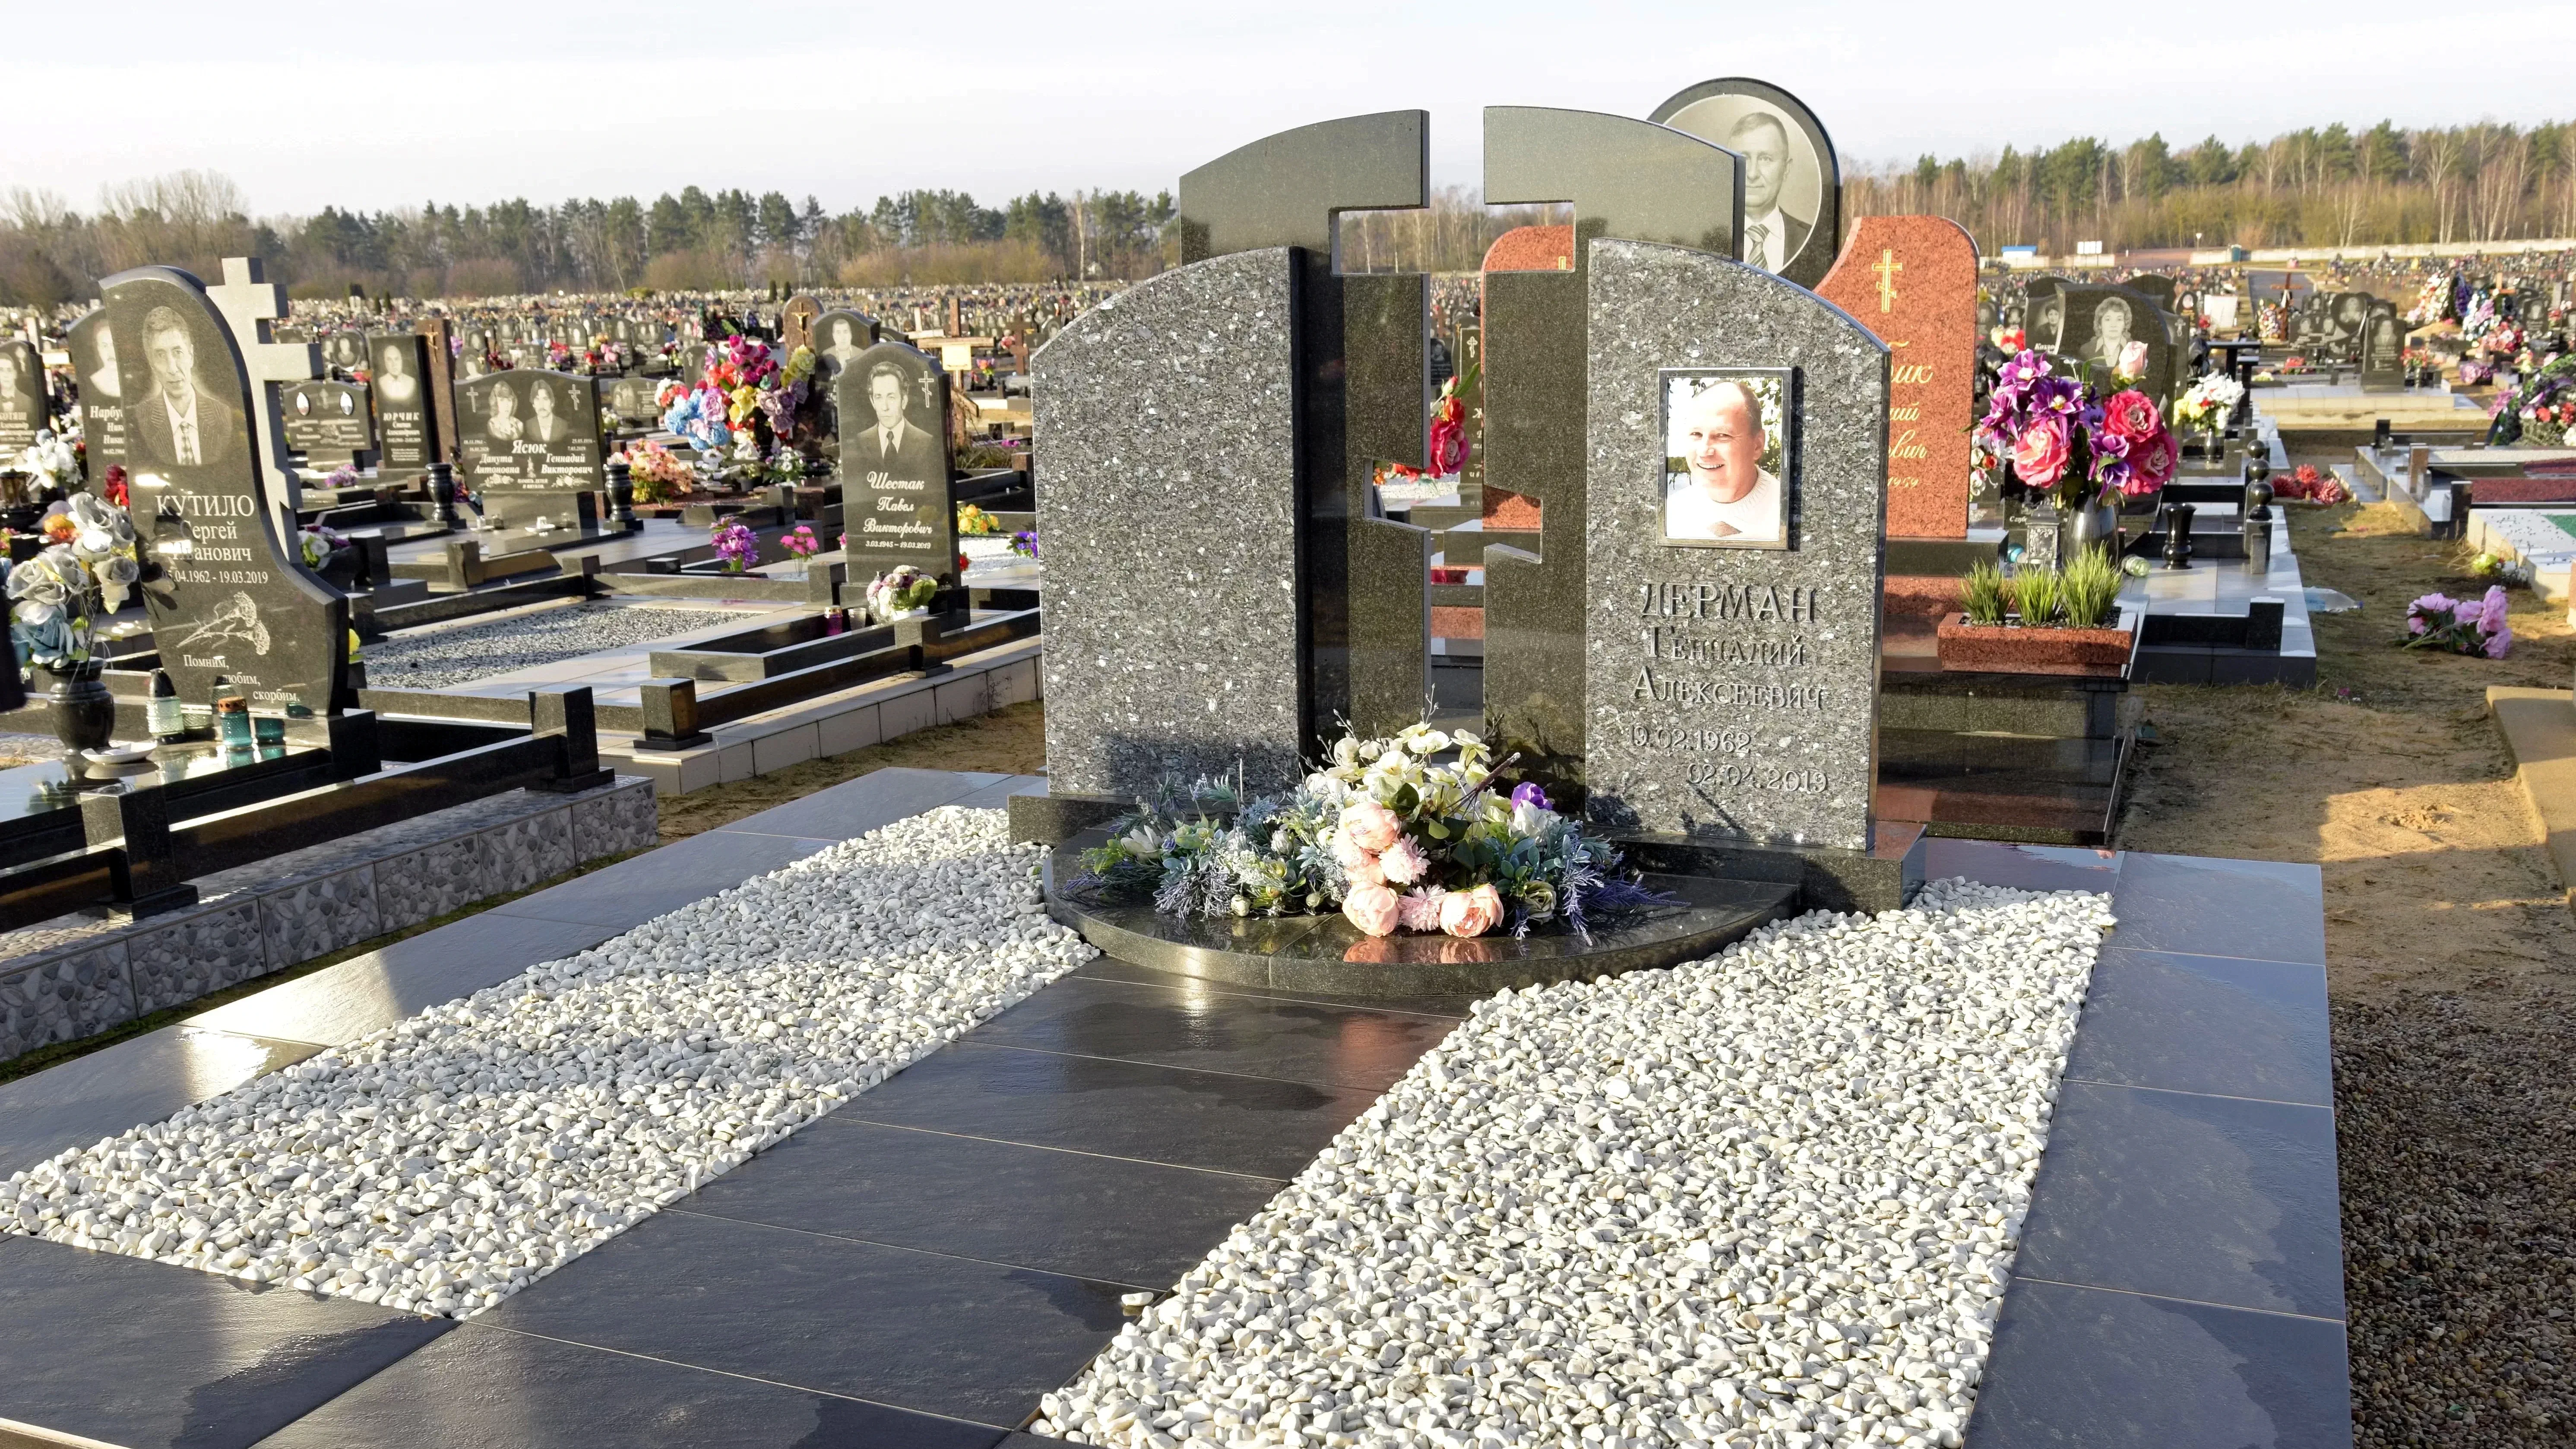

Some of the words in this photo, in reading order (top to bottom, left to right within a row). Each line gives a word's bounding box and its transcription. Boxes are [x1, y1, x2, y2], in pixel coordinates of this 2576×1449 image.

[89, 405, 123, 422] Нарбу
[512, 440, 547, 454] Ясюк
[479, 454, 513, 465] Данута
[546, 453, 585, 463] Геннадий
[474, 465, 520, 474] Антоновна
[541, 464, 593, 476] Викторович
[867, 471, 925, 490] Шестак
[155, 495, 255, 517] КУТИЛО
[877, 497, 915, 511] Павел
[180, 520, 237, 544] Сергей
[863, 518, 933, 539] Викторович
[219, 571, 269, 583] 19.03.2019
[1641, 582, 1814, 623] ДЕРМАН
[183, 654, 229, 670] Помним,
[222, 672, 261, 686] любим,
[253, 688, 300, 703] скорбим.
[1628, 724, 1751, 754] 19.02.1962
